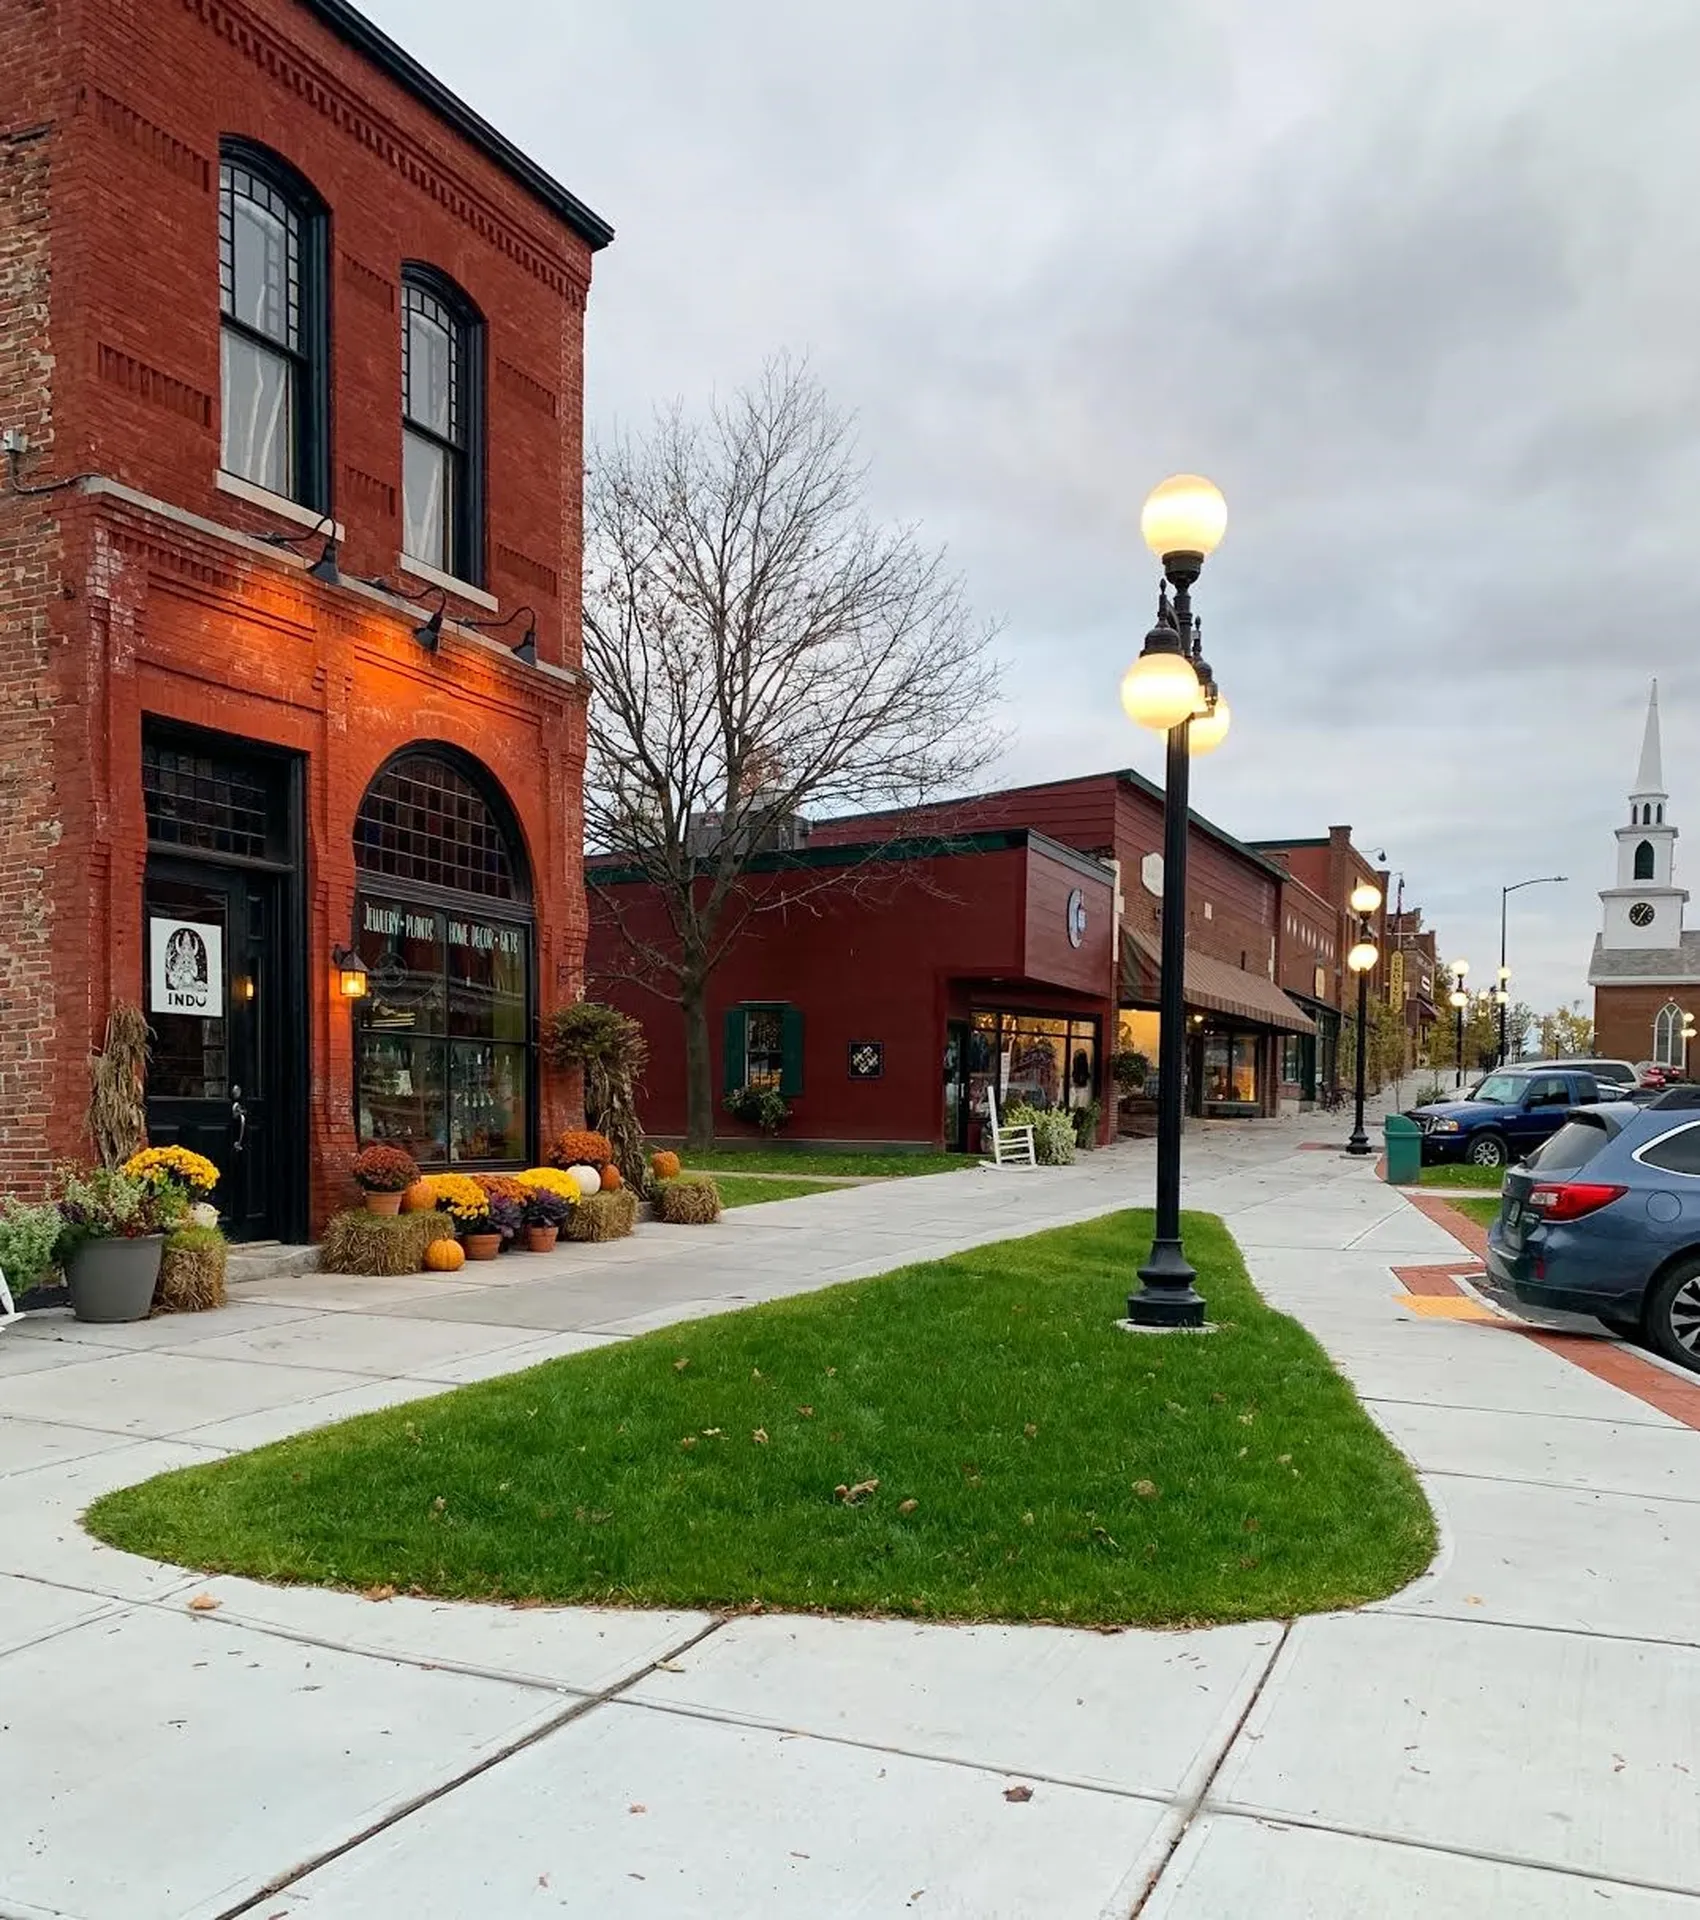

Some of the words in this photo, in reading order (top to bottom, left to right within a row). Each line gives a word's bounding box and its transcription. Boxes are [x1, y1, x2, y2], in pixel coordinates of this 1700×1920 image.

[405, 914, 434, 942] PLANTS
[448, 921, 469, 946] HOME
[471, 925, 494, 949] DECOR
